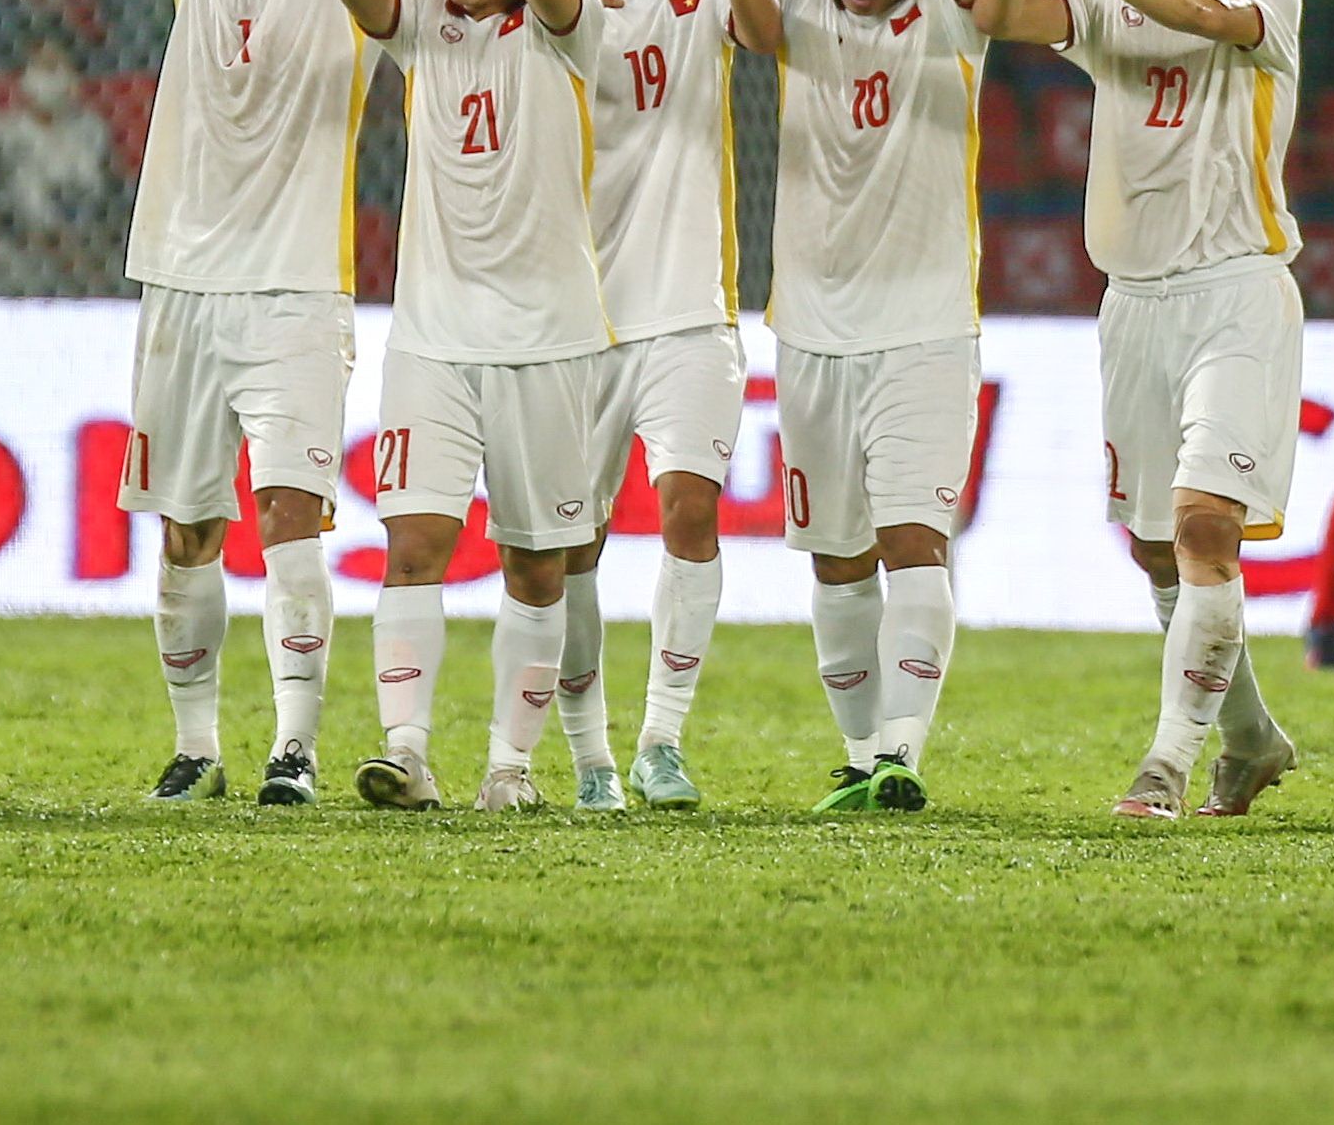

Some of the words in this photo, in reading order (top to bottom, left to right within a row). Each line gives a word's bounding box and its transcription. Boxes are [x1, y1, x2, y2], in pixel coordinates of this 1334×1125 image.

[625, 45, 668, 112] 19
[852, 70, 891, 129] 10
[1145, 67, 1189, 129] 22
[460, 90, 501, 155] 21
[377, 427, 411, 493] 21
